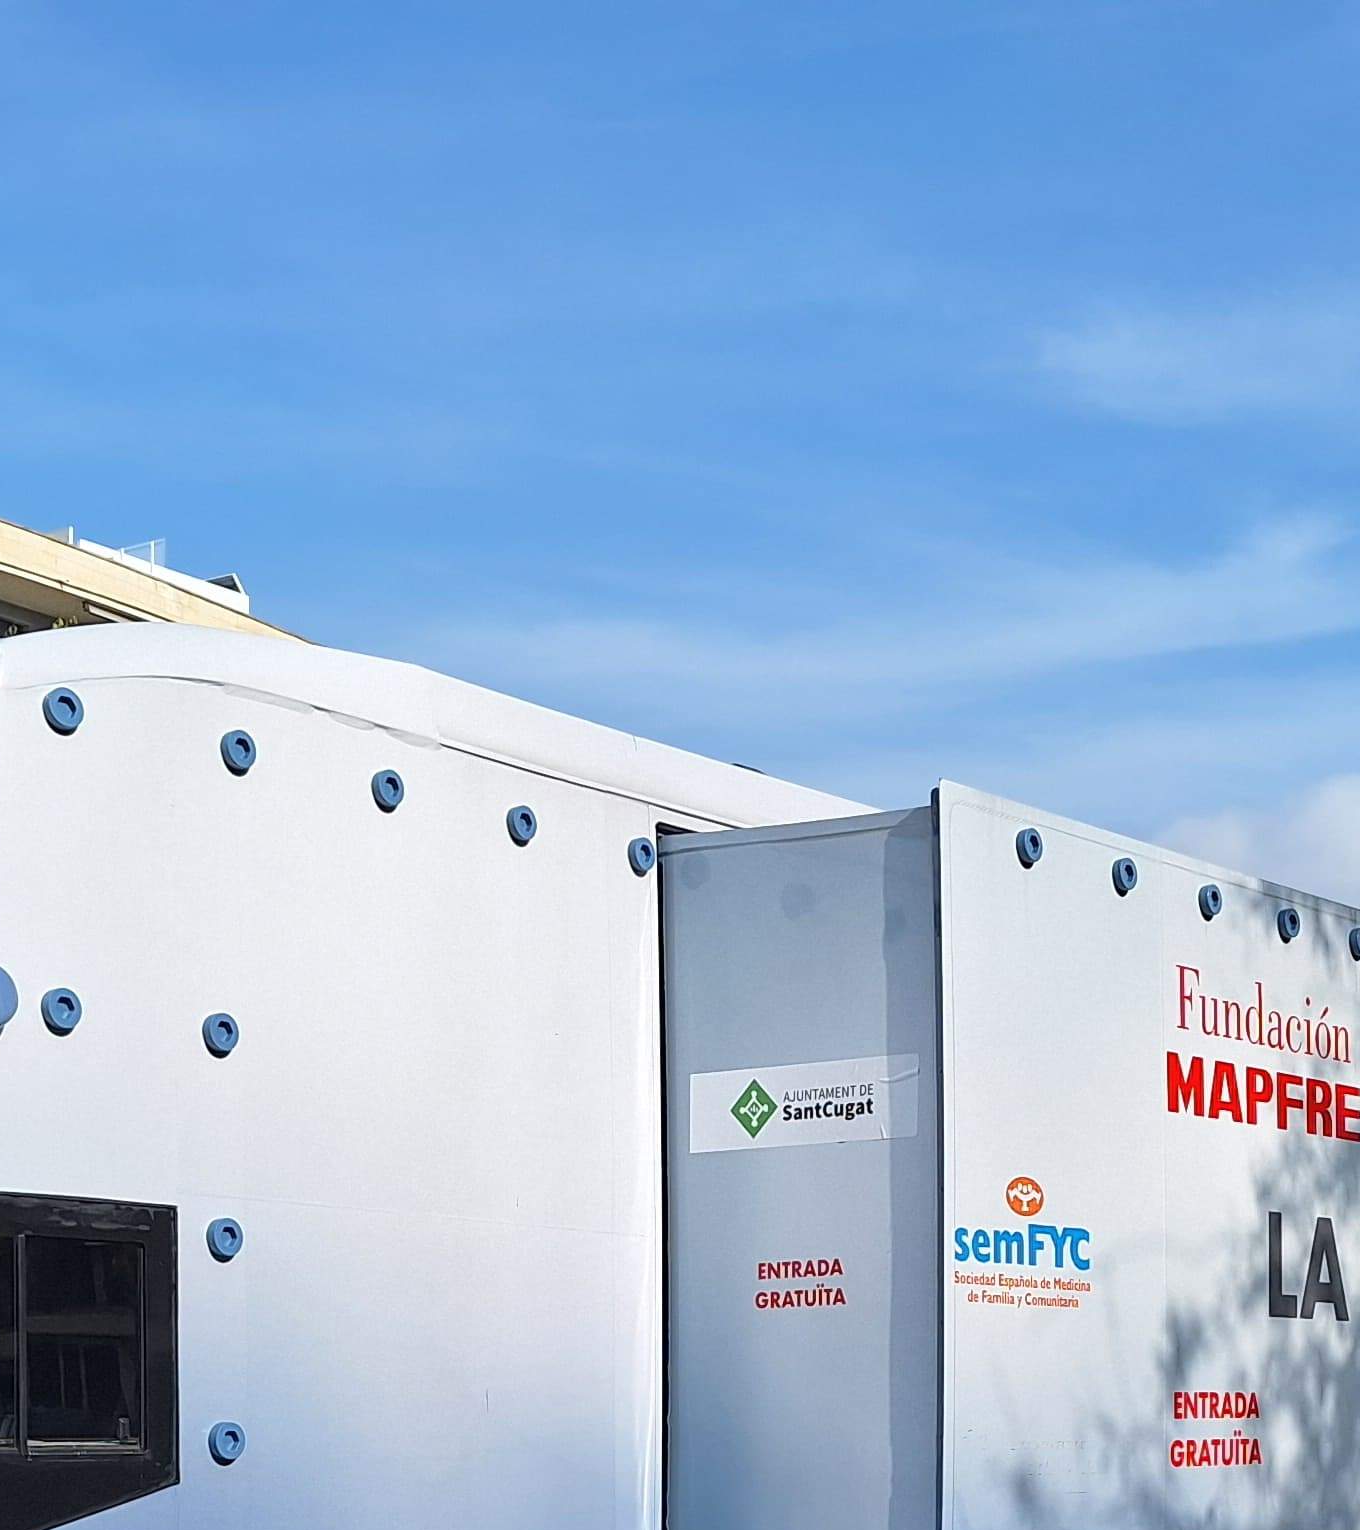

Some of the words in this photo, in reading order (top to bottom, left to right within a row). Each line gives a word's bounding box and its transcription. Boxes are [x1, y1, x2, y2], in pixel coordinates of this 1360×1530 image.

[1175, 964, 1352, 1064] Fundación
[783, 1085, 857, 1103] AJUNTAMENT
[859, 1083, 874, 1097] DE
[782, 1097, 874, 1121] SantCugat
[954, 1223, 1091, 1272] semFYC
[757, 1258, 844, 1280] ENTRADA
[1268, 1211, 1350, 1322] LA
[954, 1270, 996, 1287] Sociedad
[998, 1273, 1038, 1290] Española
[1040, 1277, 1051, 1290] de
[1053, 1278, 1091, 1292] Medicina
[755, 1283, 847, 1309] GRATUÏTA
[967, 1290, 979, 1303] de
[981, 1290, 1015, 1305] Familia
[1017, 1295, 1023, 1308] y
[1024, 1292, 1079, 1308] Comunitaria
[1173, 1391, 1260, 1420] ENTRADA
[1170, 1429, 1262, 1468] GRATUÏTA
